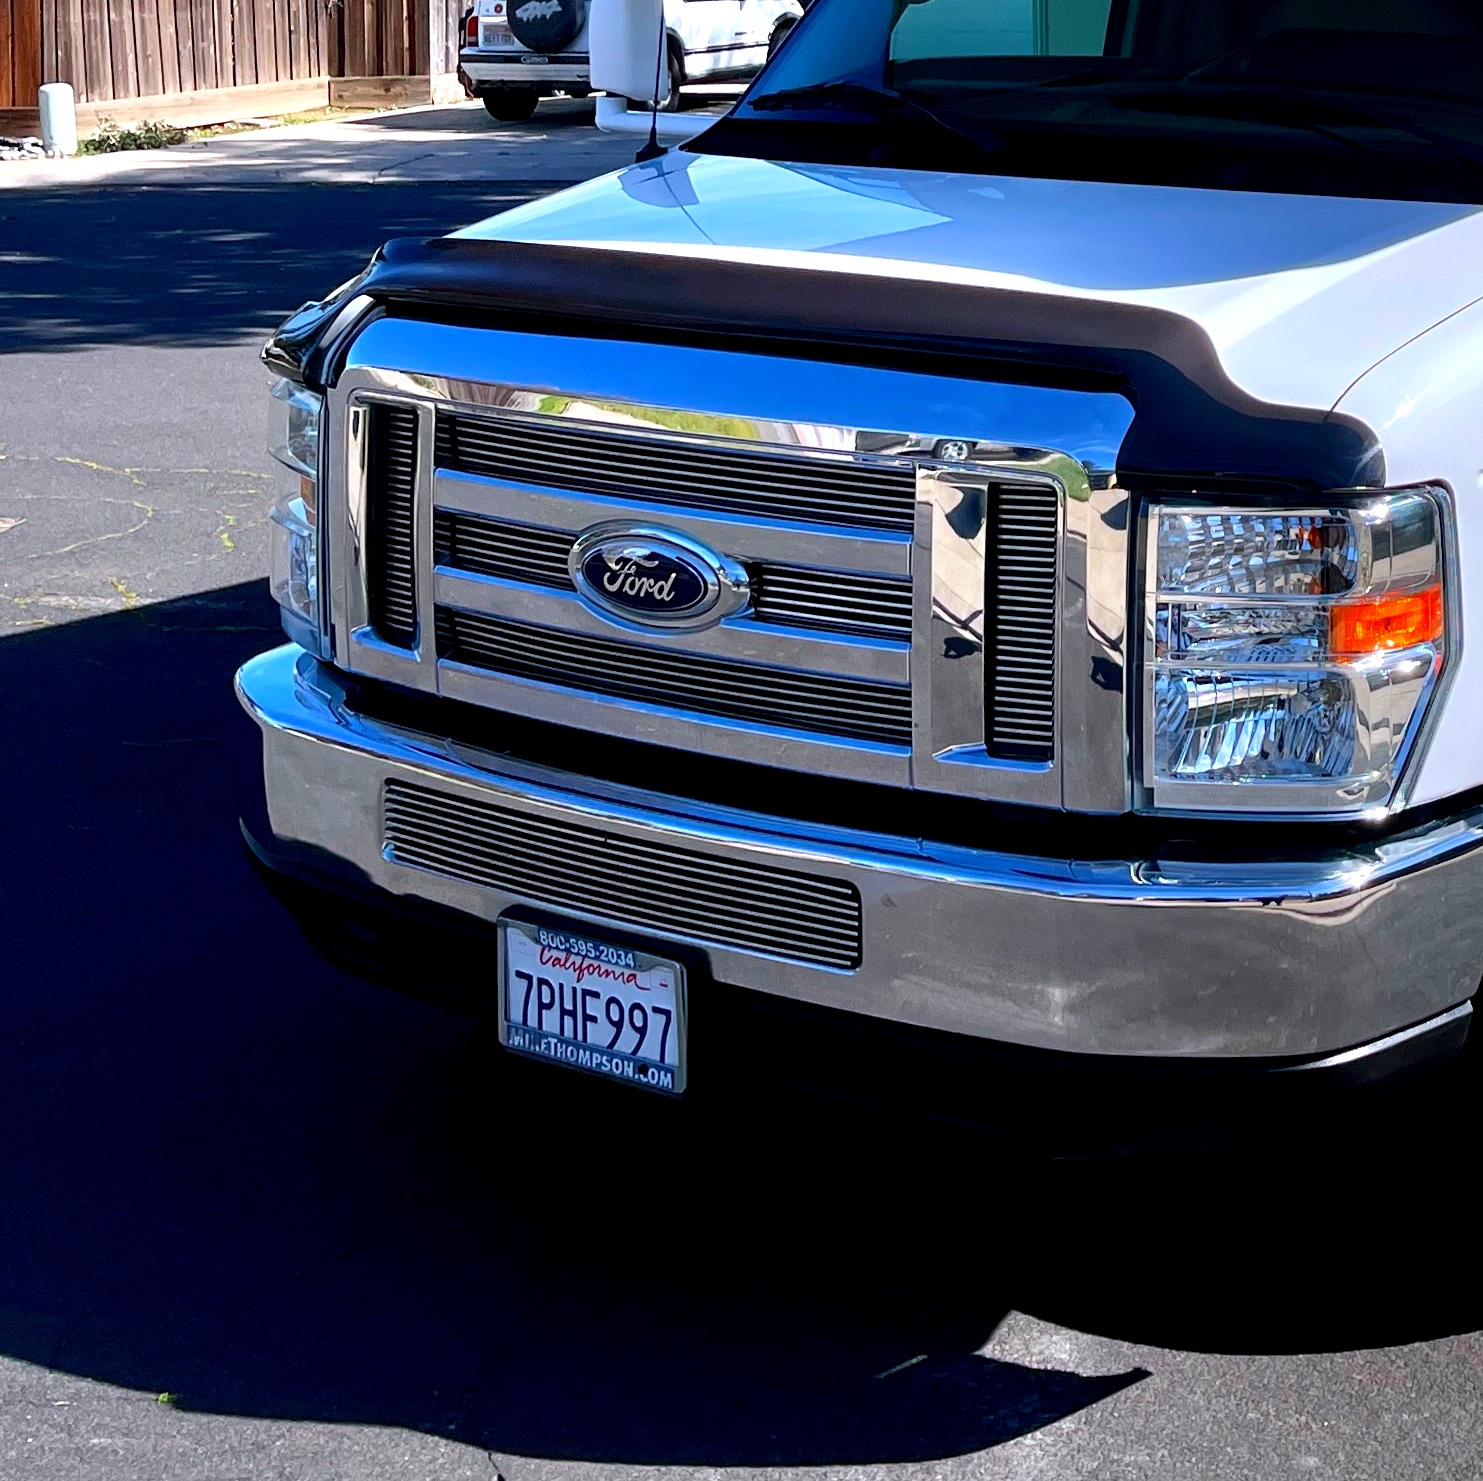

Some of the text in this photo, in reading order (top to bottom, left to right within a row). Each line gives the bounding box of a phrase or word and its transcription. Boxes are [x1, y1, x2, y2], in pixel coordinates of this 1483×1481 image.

[603, 550, 676, 601] Ford
[539, 947, 651, 991] California
[515, 970, 672, 1064] 7PHF997
[509, 1028, 672, 1089] MIETHOMPSON.OM
